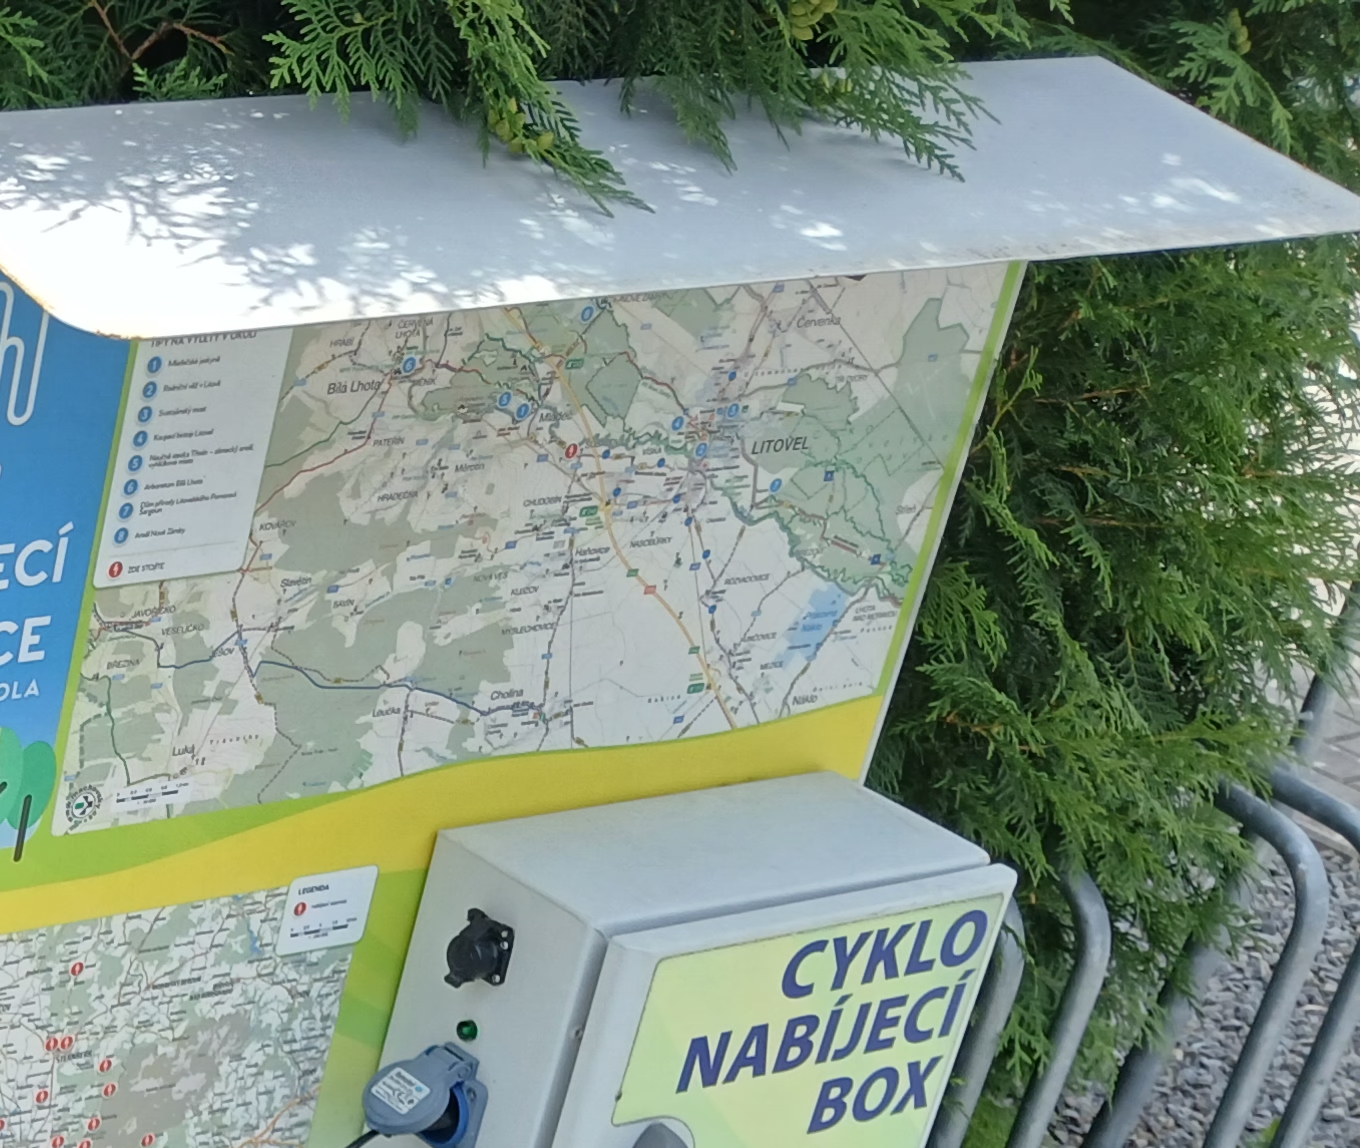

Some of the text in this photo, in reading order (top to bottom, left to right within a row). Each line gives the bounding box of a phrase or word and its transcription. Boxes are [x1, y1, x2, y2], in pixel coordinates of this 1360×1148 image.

[327, 380, 381, 395] Bílá Lhota
[751, 436, 809, 455] LITOVEL
[781, 909, 989, 999] CYKLO
[676, 969, 976, 1094] NABÍJECÍ
[806, 1056, 943, 1135] BOX
